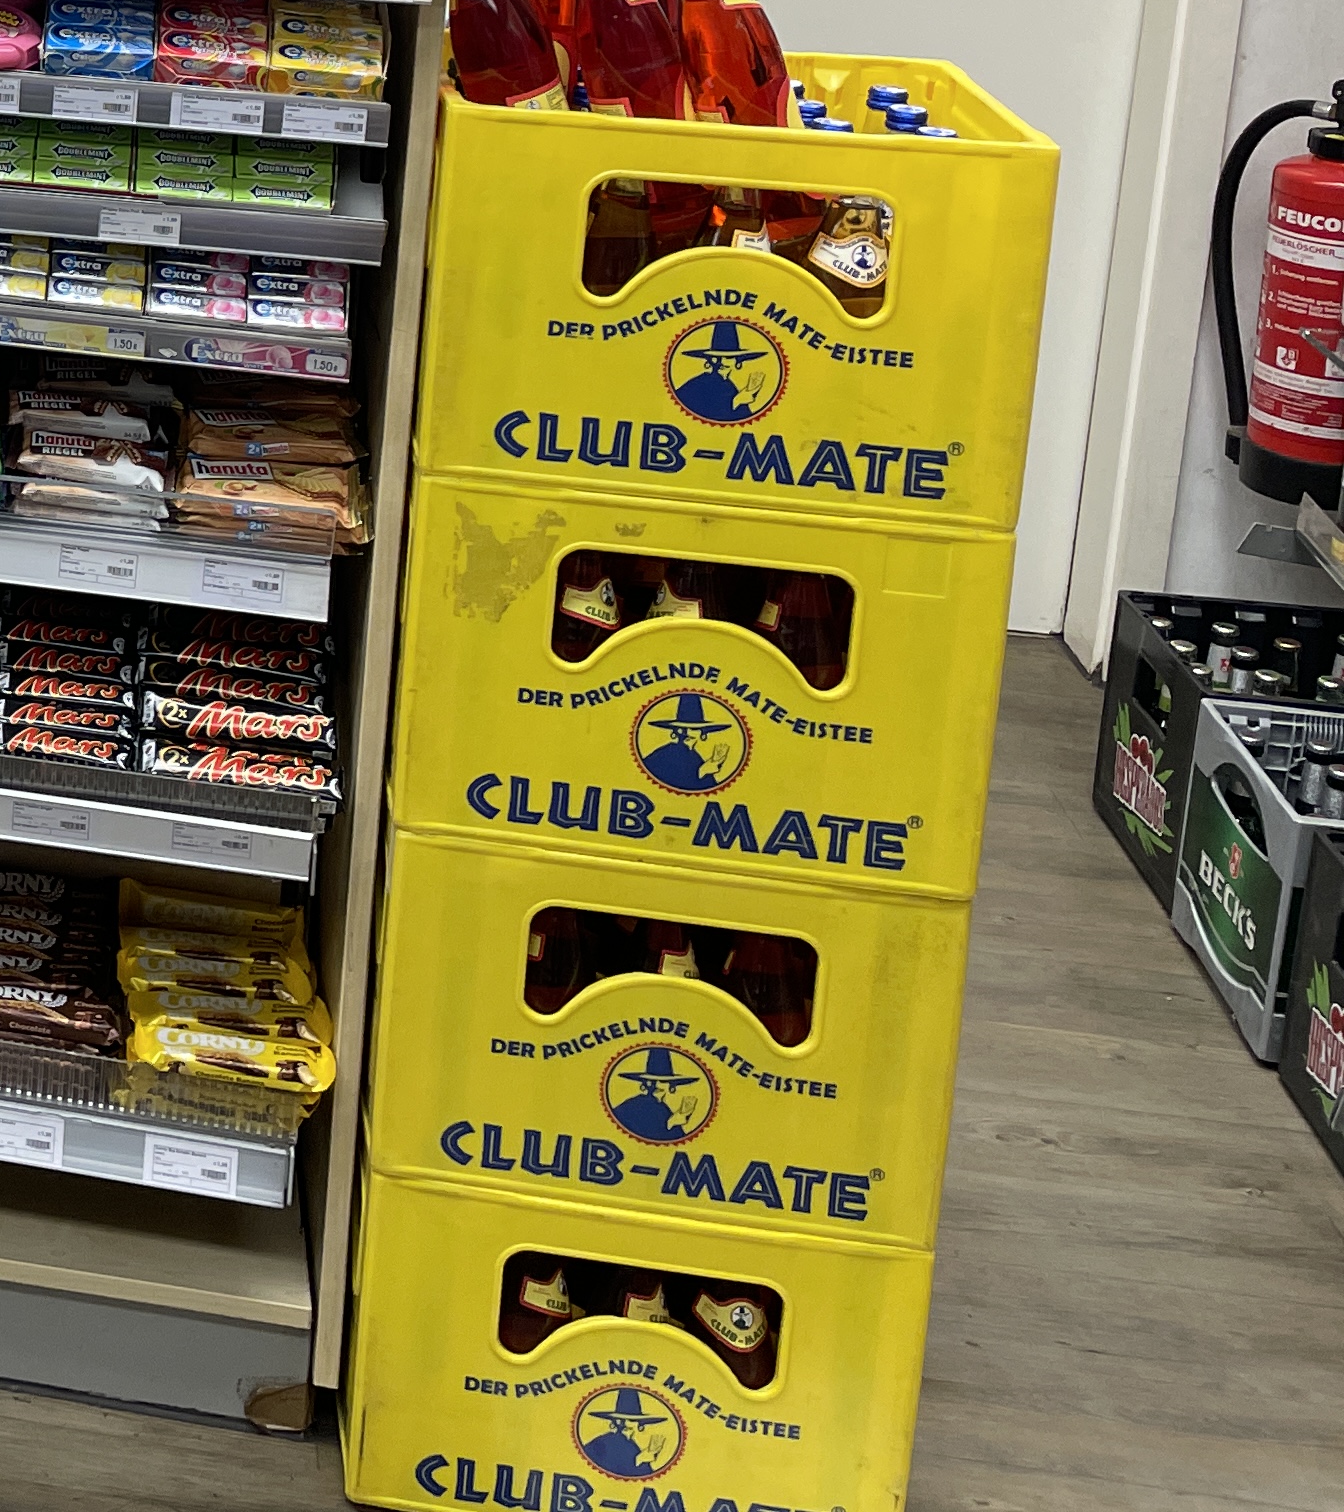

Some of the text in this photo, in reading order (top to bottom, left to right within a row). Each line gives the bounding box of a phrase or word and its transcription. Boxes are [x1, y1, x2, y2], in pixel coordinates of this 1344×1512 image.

[256, 186, 308, 202] DOUBLEMINT
[1277, 206, 1344, 233] FEUCO
[1272, 235, 1336, 256] FEUERLÖSCHER
[547, 289, 914, 369] DER PRICKELNDE MATE-EISTEE
[32, 432, 94, 449] hanuta
[42, 445, 84, 456] RIEGEL
[494, 410, 950, 501] CLUB-MATE
[188, 701, 330, 743] Mars
[517, 661, 874, 744] DER PRICKELNDE MATE-EISTEE
[467, 772, 909, 871] CLUB-MATE
[1199, 848, 1258, 952] BECK'S
[491, 1016, 838, 1101] DER PRICKELNDE MATE-EISTEE
[439, 1120, 871, 1222] CLUB-MATE
